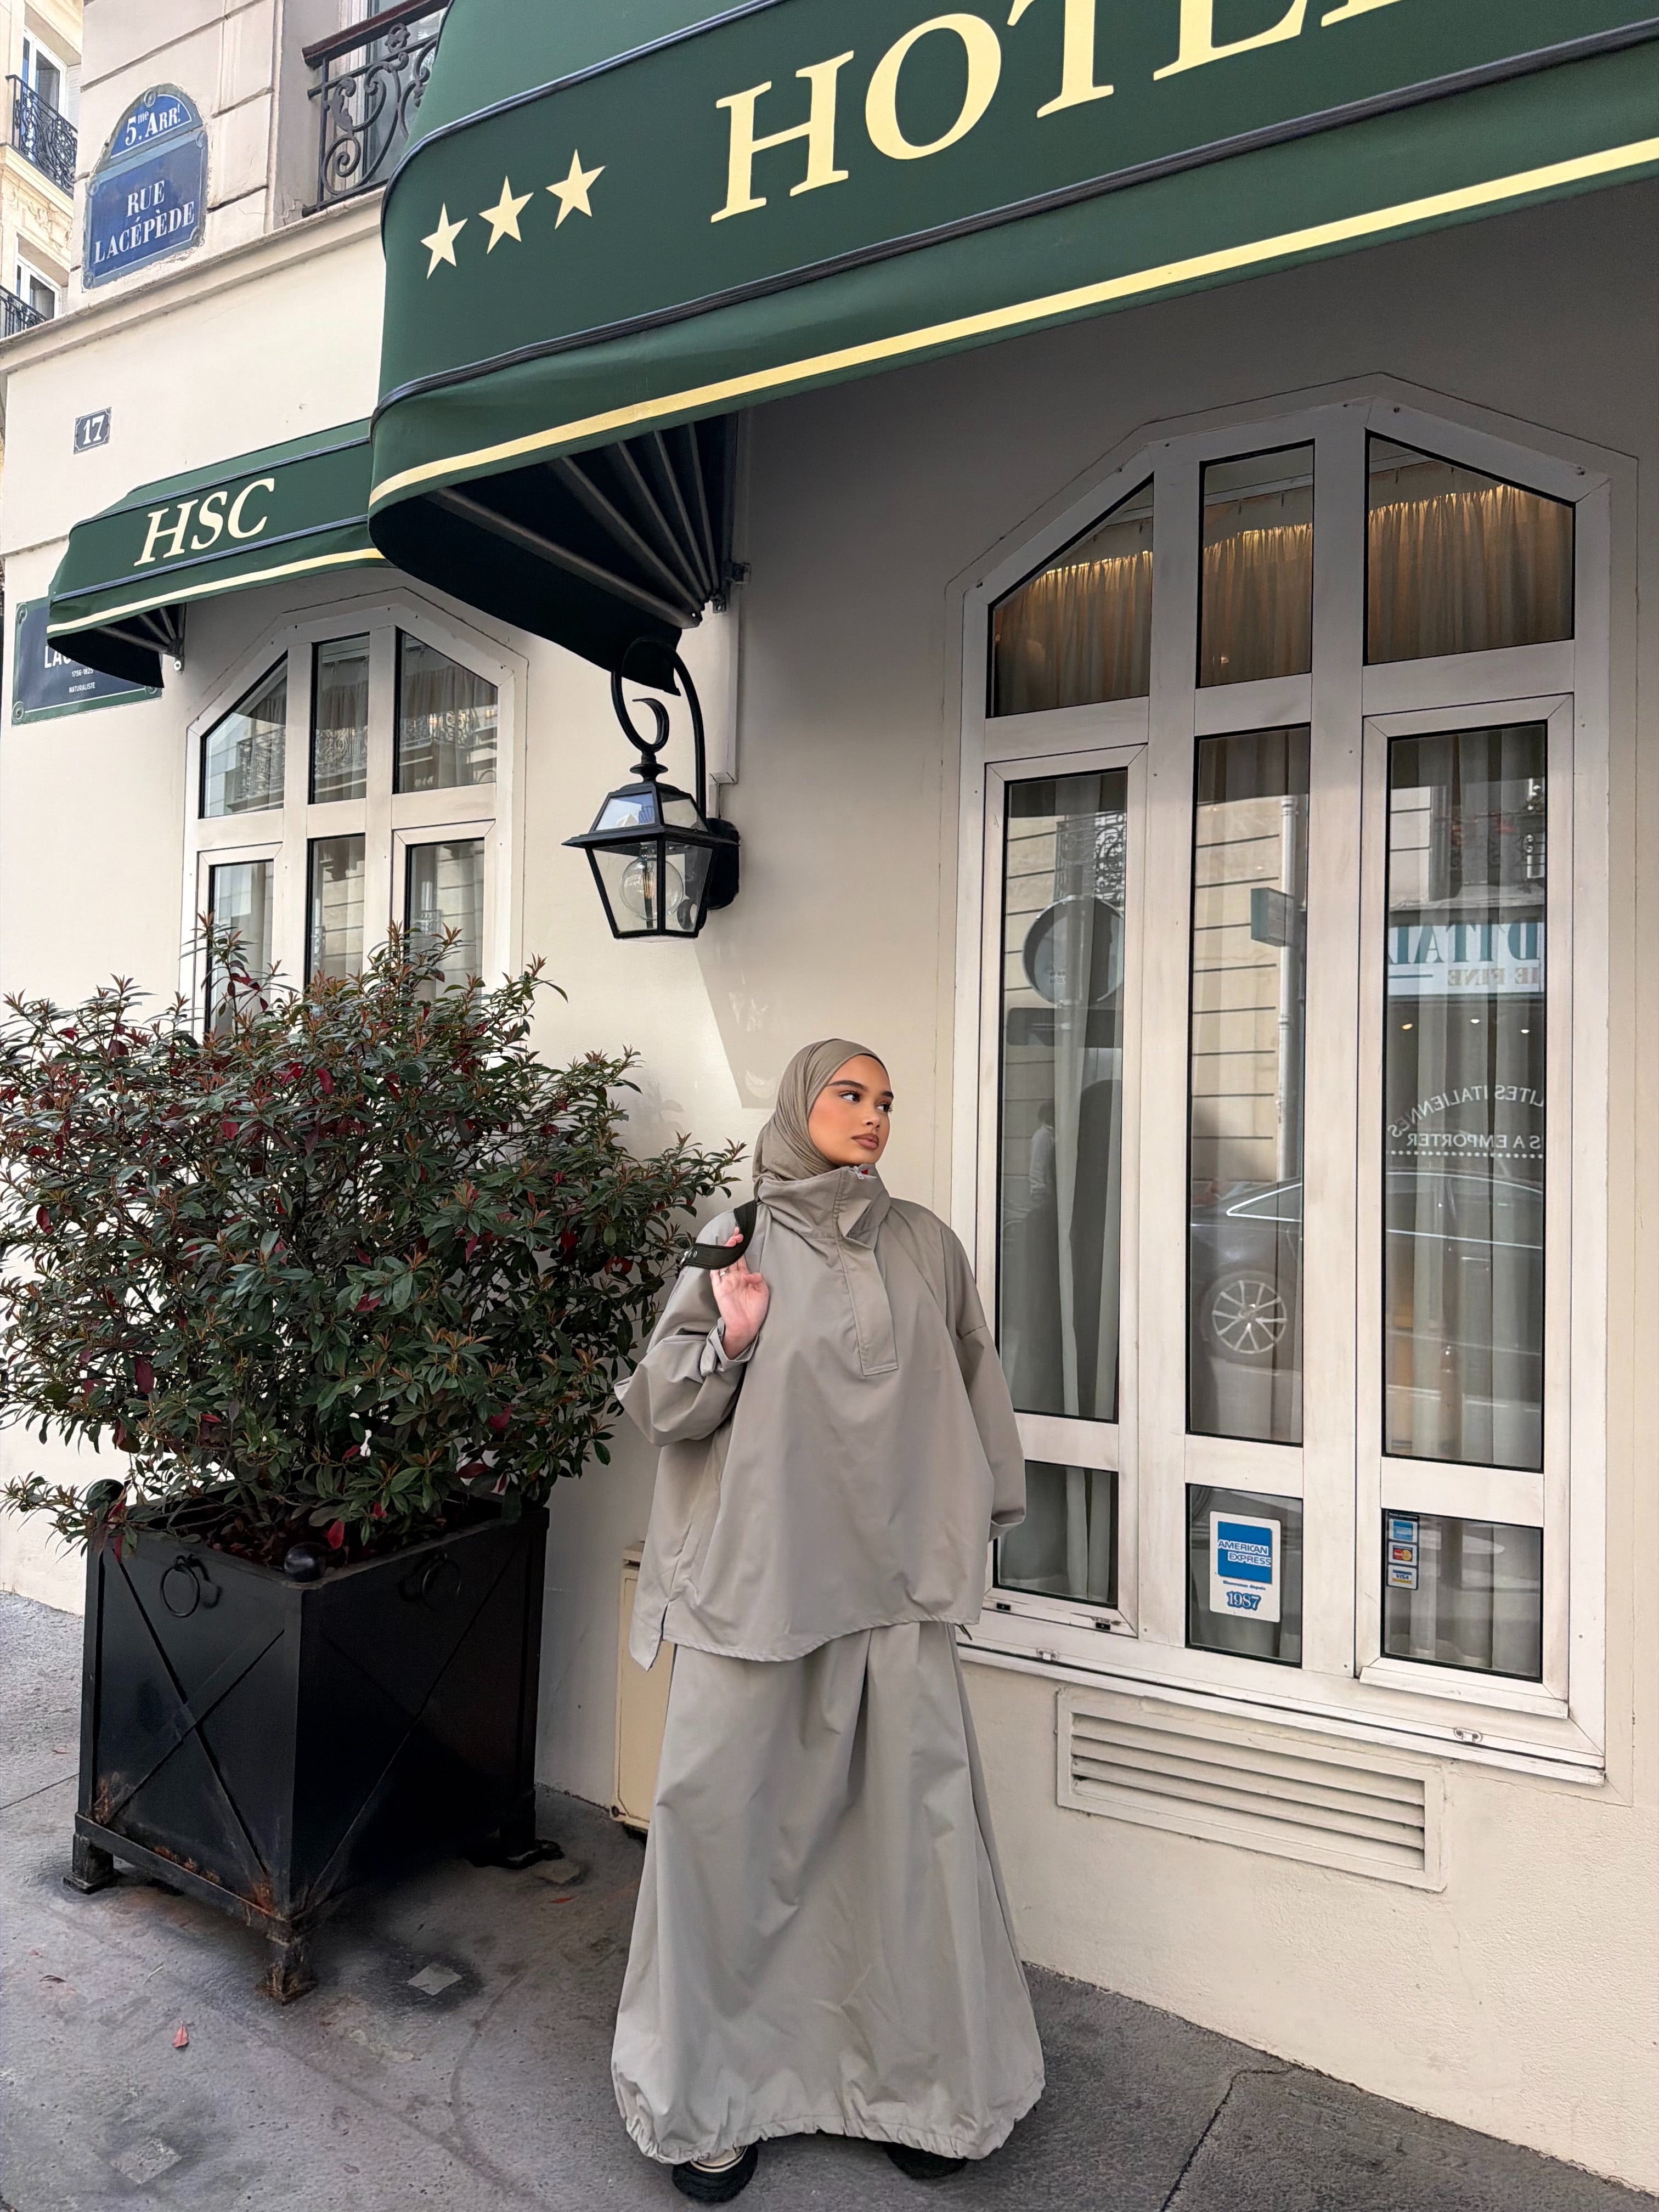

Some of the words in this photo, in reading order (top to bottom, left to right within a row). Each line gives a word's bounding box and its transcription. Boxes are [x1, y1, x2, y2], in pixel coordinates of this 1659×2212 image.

[710, 0, 1403, 223] HOT
[126, 180, 165, 217] RUE
[93, 201, 195, 264] LACÉPÈDE
[83, 415, 105, 444] 17
[134, 478, 274, 566] HSC
[69, 682, 96, 693] NATURALISTE
[1217, 1540, 1268, 1555] AMERICAN
[1228, 1553, 1272, 1566] EXPRESS
[1227, 1592, 1260, 1610] 1987
